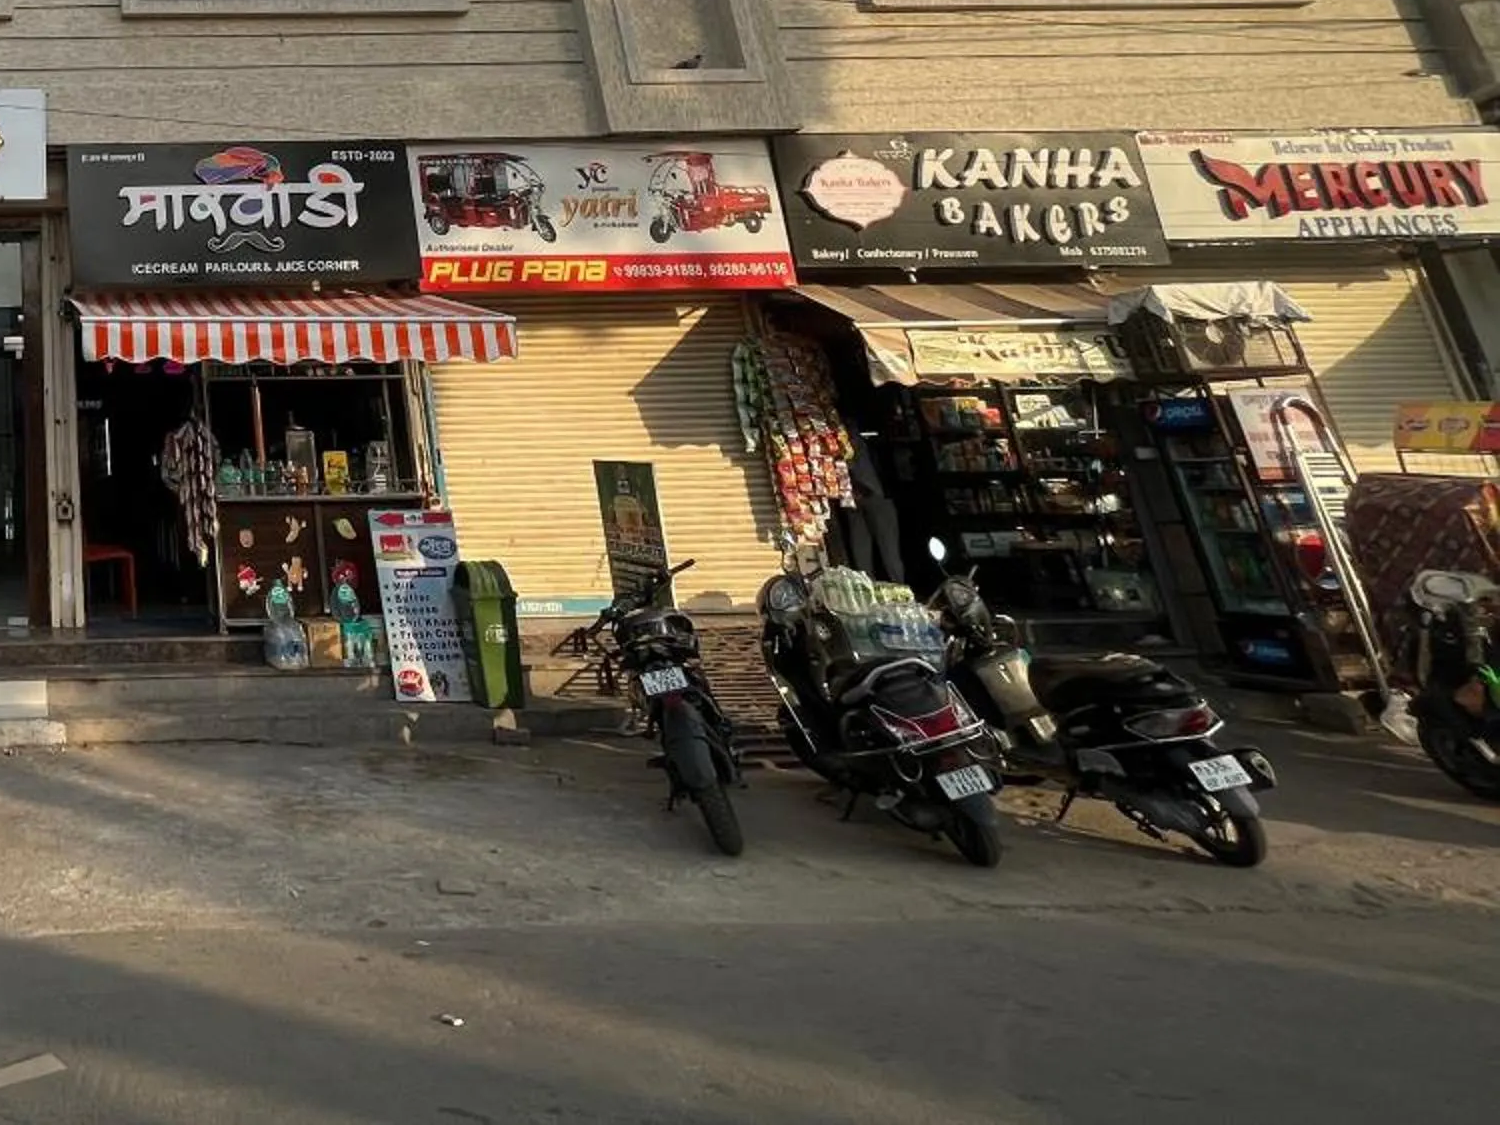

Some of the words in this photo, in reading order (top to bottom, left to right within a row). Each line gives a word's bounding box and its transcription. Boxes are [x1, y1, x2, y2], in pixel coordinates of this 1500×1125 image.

[916, 146, 1143, 190] KANHA
[1188, 148, 1489, 221] MERCURY
[936, 195, 1131, 244] BAKERS
[1297, 213, 1460, 238] APPLIANCES
[307, 260, 360, 272] CORNER
[429, 260, 515, 284] PLUG
